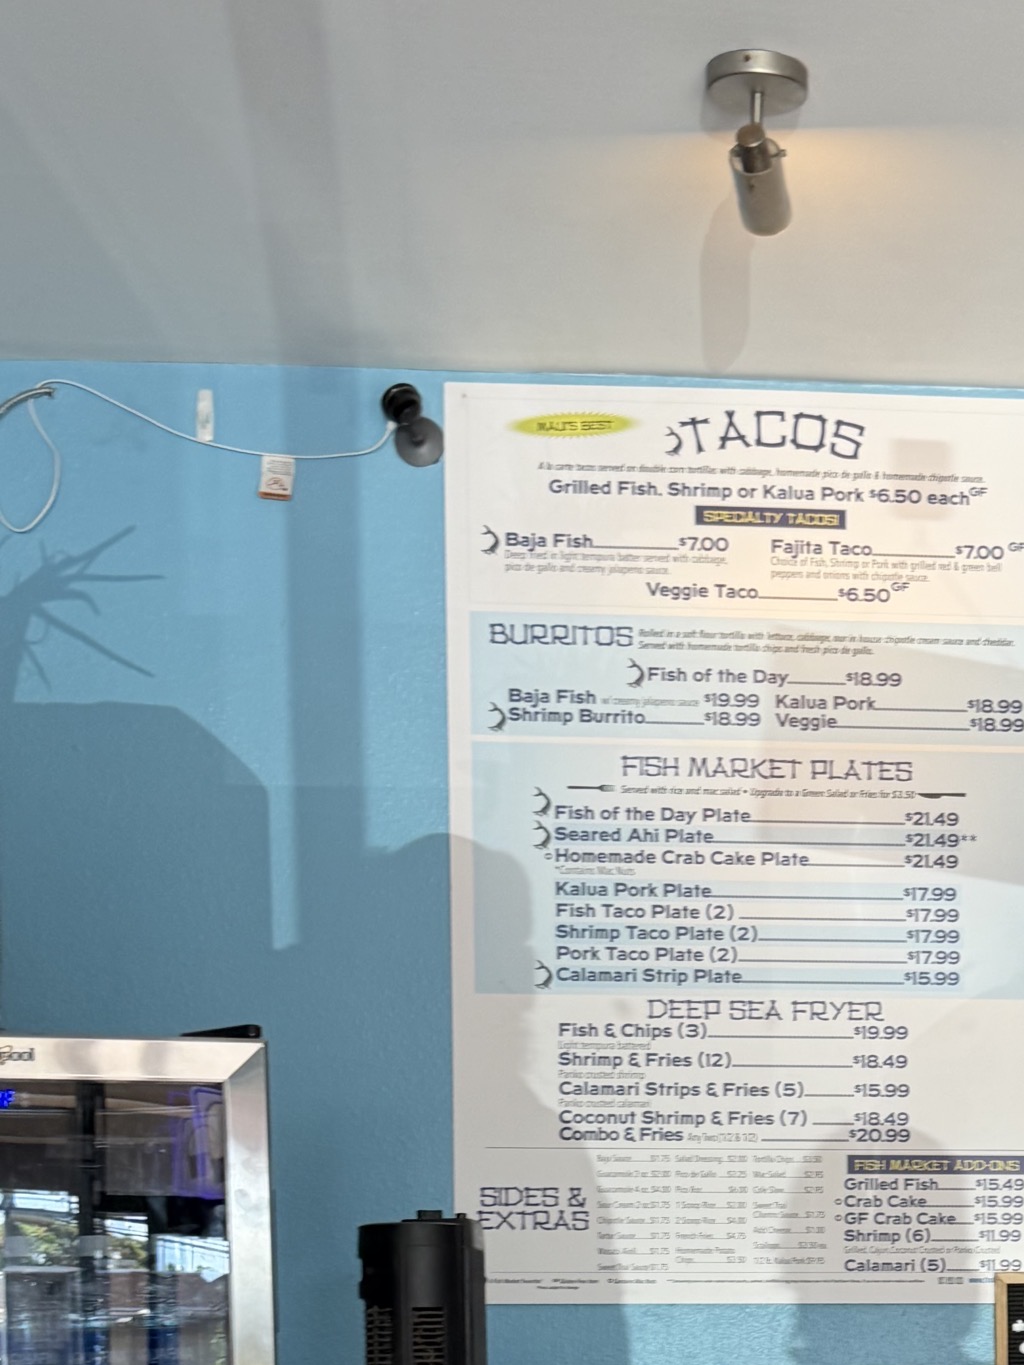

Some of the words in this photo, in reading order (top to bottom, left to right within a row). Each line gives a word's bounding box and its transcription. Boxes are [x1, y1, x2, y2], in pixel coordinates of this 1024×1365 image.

[679, 410, 866, 460] TACOS
[549, 479, 618, 497] Grilled
[668, 481, 733, 502] Shrimp
[738, 486, 758, 500] or
[762, 484, 816, 501] Kalua
[820, 486, 865, 503] Pork
[868, 488, 922, 504] $6.50
[926, 490, 969, 506] each
[703, 510, 783, 524] SPECIALTY
[771, 539, 824, 558] Fajita
[829, 541, 873, 556] Taco
[955, 545, 1004, 560] $7.00
[489, 623, 634, 646] BURRITOS
[508, 707, 574, 725] Shrimp
[578, 709, 646, 725] Burrito
[704, 711, 761, 726] $18.99
[775, 713, 838, 731] Veggie
[620, 756, 680, 779] FISH
[687, 757, 803, 780] MARKET
[810, 759, 913, 782] PLATES
[554, 849, 656, 866] Homemade
[660, 850, 706, 866] Crab
[710, 850, 757, 866] Cake
[761, 852, 810, 867] Plate
[904, 853, 958, 869] $21.49
[555, 882, 608, 898] Kalua
[612, 883, 659, 898] Pork
[663, 884, 712, 898] Plate
[903, 886, 957, 902] $17.99
[647, 999, 721, 1020] DEEP
[729, 1000, 783, 1020] SEA
[791, 1000, 885, 1022] FRYER
[558, 1110, 636, 1126] Coconut
[640, 1110, 706, 1129] Shrimp
[710, 1111, 725, 1127] &
[729, 1111, 776, 1127] Fries
[780, 1110, 808, 1128] (7)
[853, 1111, 910, 1126] $18.49
[854, 1160, 886, 1172] FISH
[890, 1160, 950, 1172] MARKET
[955, 1160, 1020, 1172] ADD-ONS
[479, 1187, 565, 1208] SIDES
[570, 1189, 588, 1208] &
[477, 1211, 590, 1232] EXTRAS
[843, 1258, 915, 1272] Calamari
[919, 1257, 948, 1274] (5)
[979, 1257, 1022, 1272] $11.99
